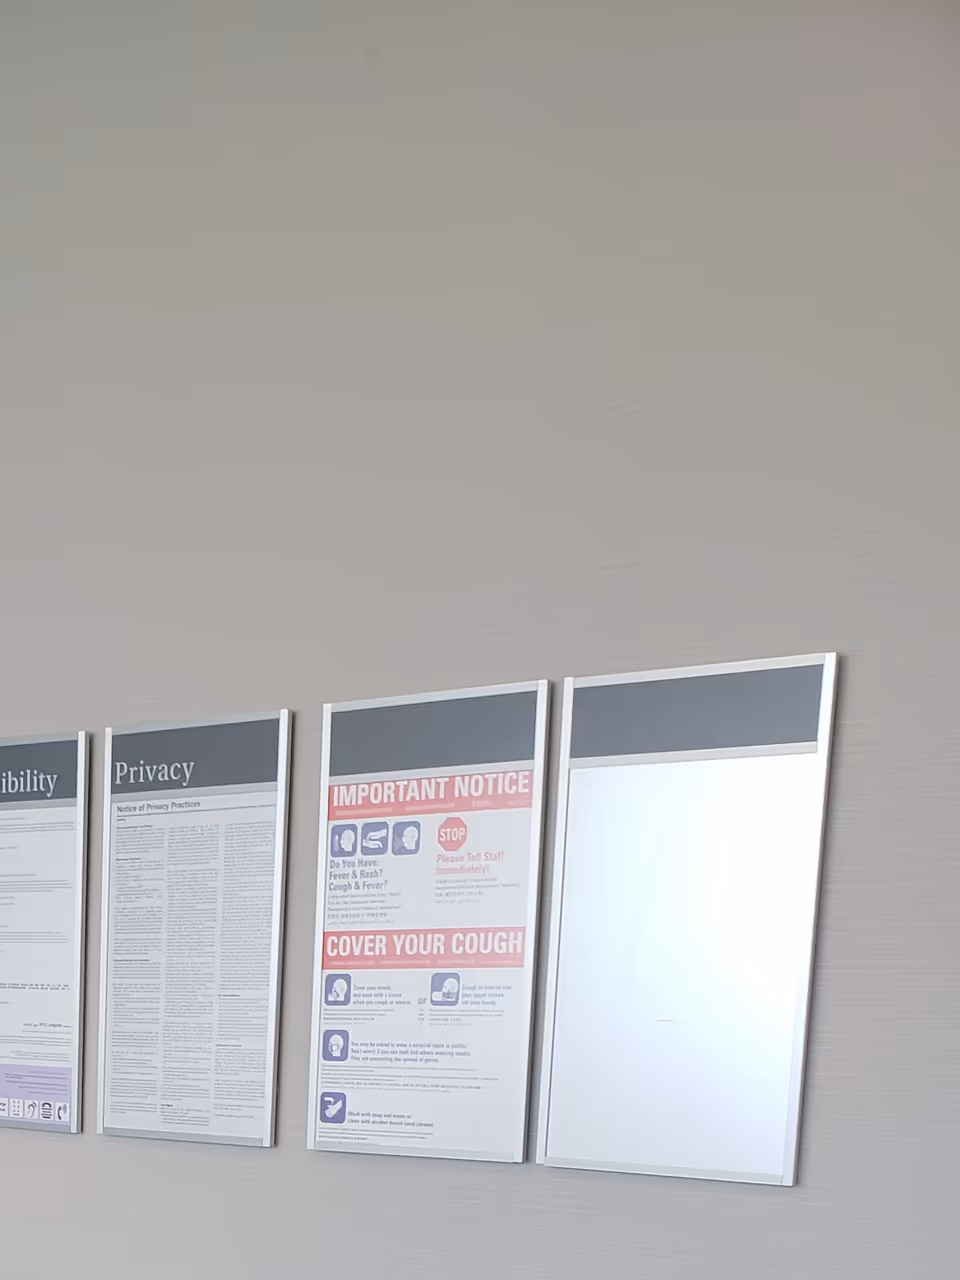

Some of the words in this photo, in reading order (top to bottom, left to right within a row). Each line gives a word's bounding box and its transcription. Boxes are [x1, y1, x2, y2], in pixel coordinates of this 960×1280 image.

[114, 760, 195, 786] Privacy
[333, 778, 449, 807] IMPORTANT
[454, 771, 529, 798] NOTICE
[117, 805, 137, 813] Notice
[146, 803, 169, 812] Privacy
[171, 801, 201, 809] Practices
[439, 825, 466, 842] STOP
[330, 860, 340, 868] Do
[342, 860, 355, 868] You
[329, 871, 350, 880] Fever
[351, 870, 357, 879] &
[360, 868, 383, 879] Rash?
[329, 882, 352, 892] Cough
[354, 881, 360, 890] &
[363, 880, 388, 890] Fever?
[327, 935, 386, 957] COVER
[393, 934, 445, 955] YOUR
[451, 931, 522, 954] COUGH
